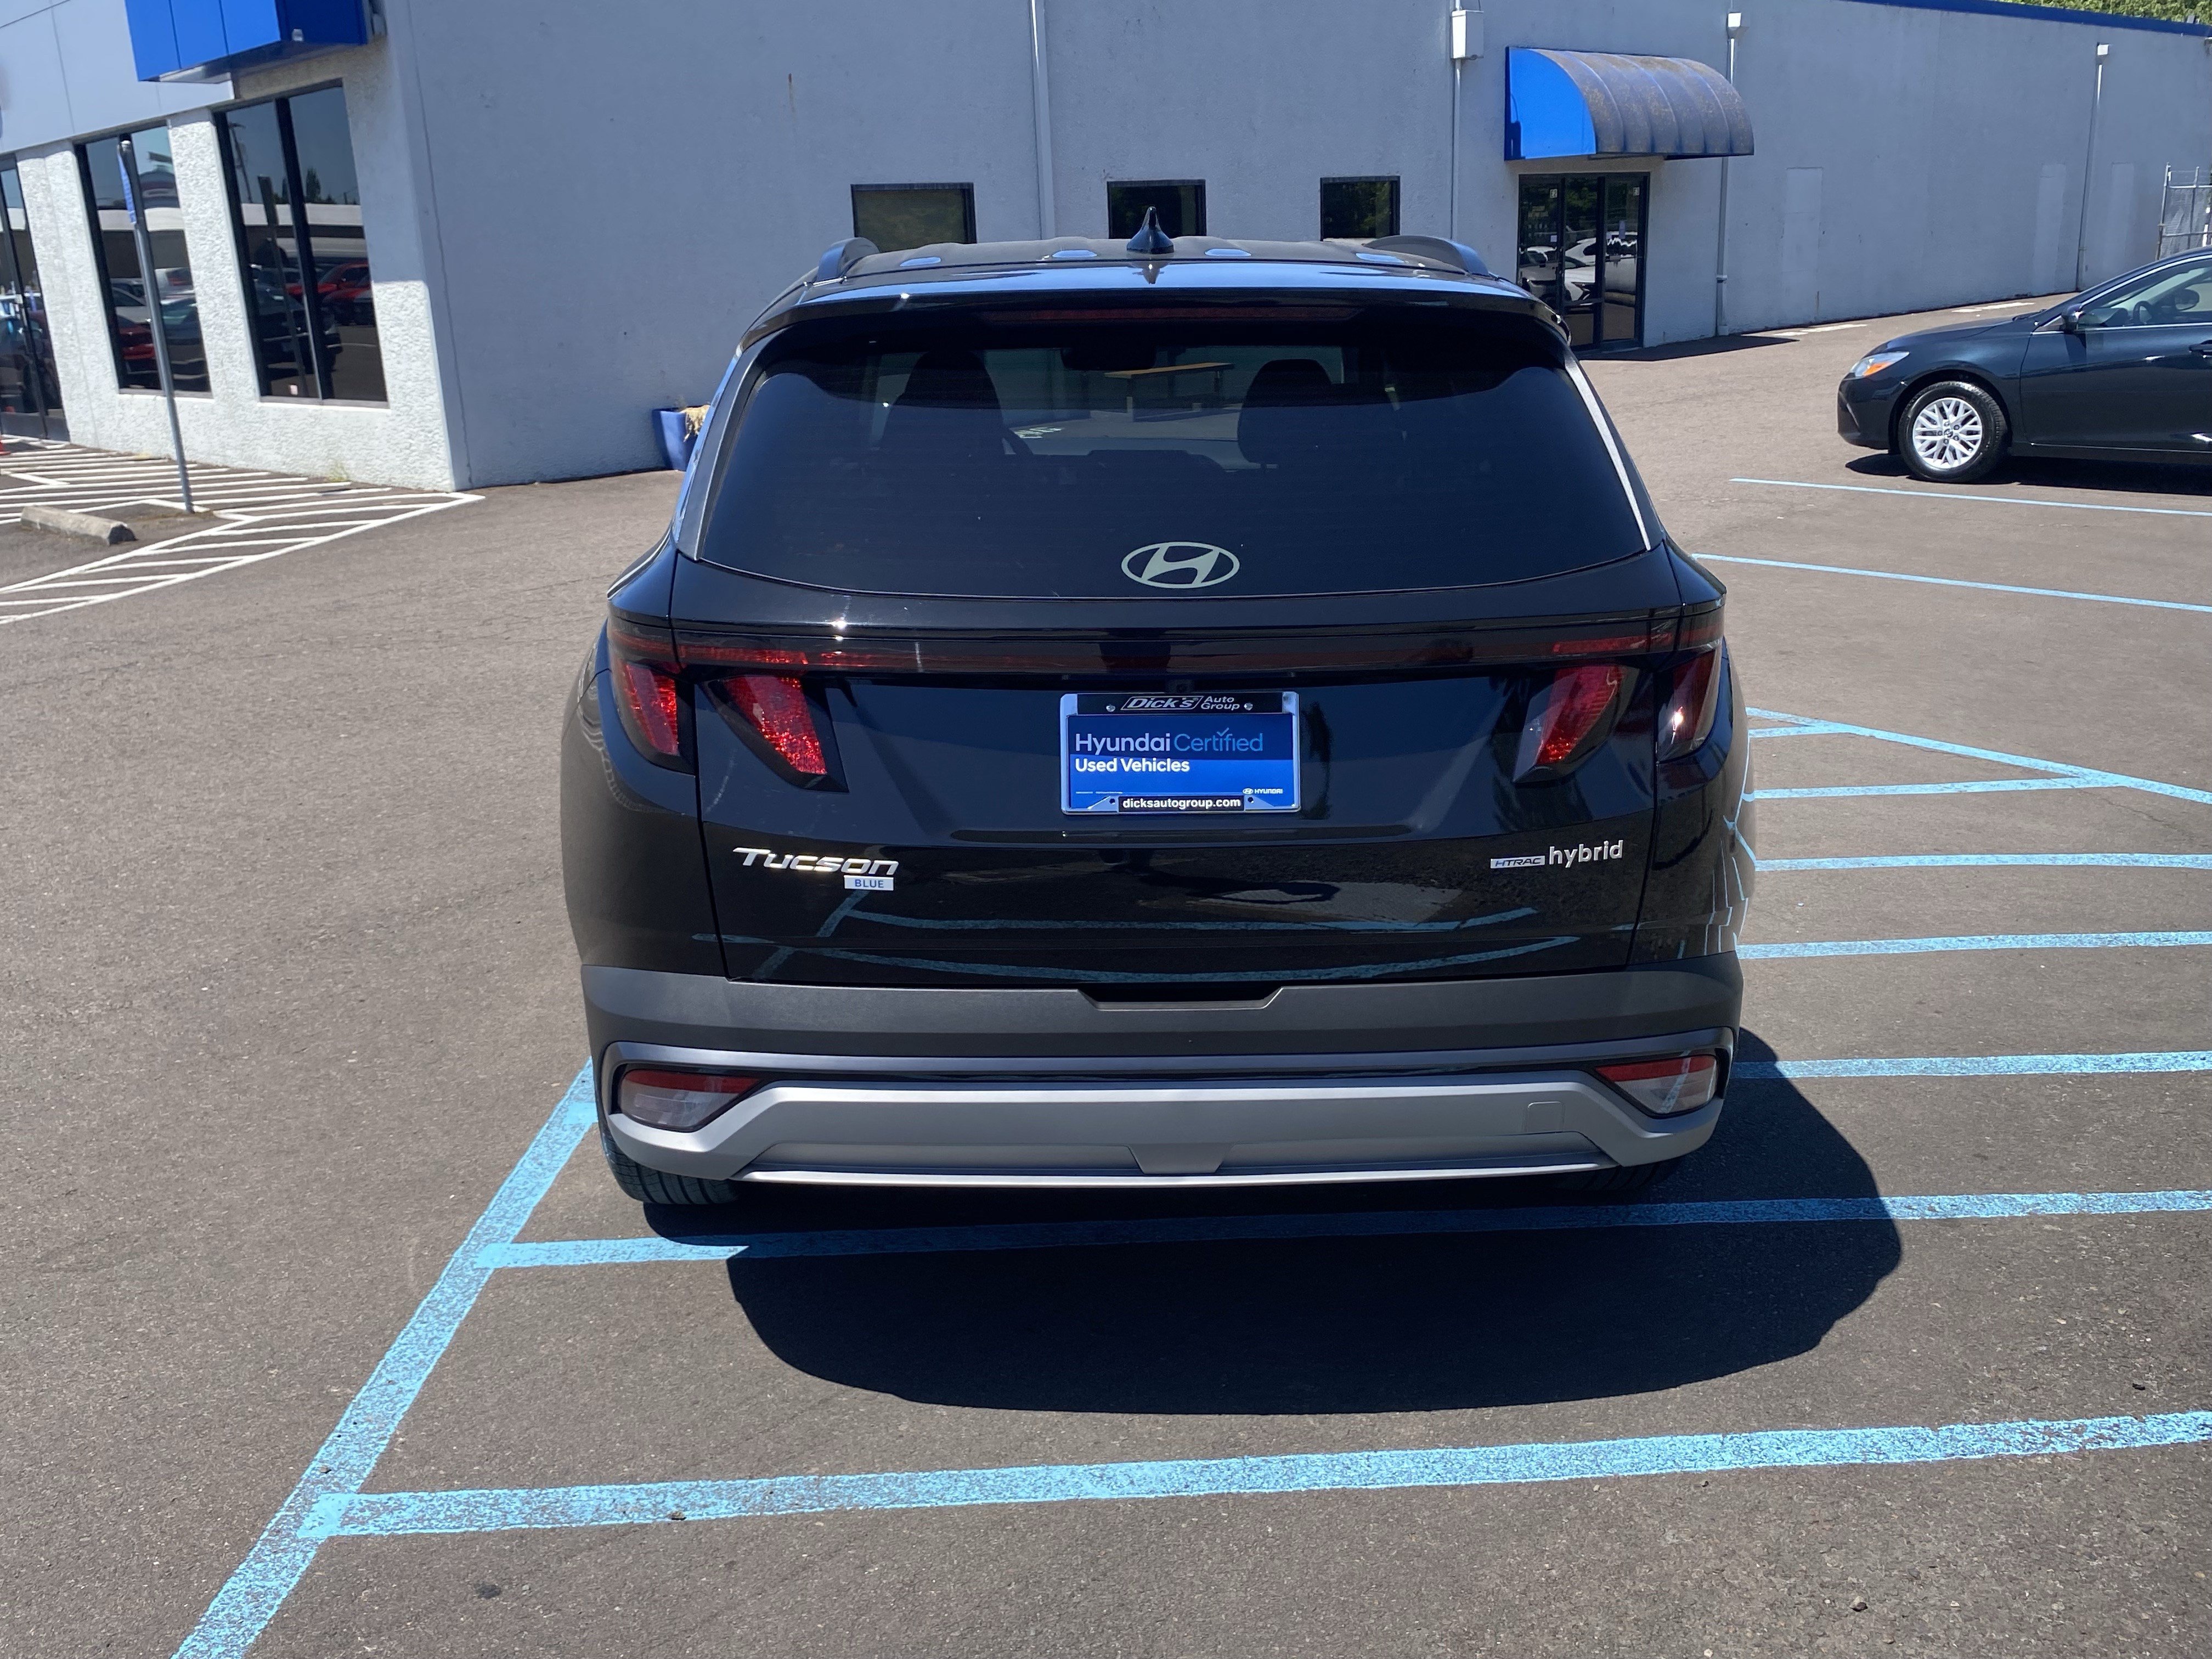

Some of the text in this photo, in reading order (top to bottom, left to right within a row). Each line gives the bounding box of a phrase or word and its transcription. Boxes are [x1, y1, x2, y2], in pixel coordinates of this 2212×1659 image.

[1127, 697, 1194, 708] Dick's
[1200, 703, 1240, 711] Group
[1075, 728, 1263, 755] Hyundai Certified
[1075, 758, 1190, 772] Used Vehicles
[1122, 798, 1241, 810] dicksautogroup.com
[1495, 840, 1623, 868] HTRAC hybrid
[855, 879, 884, 888] BLUE
